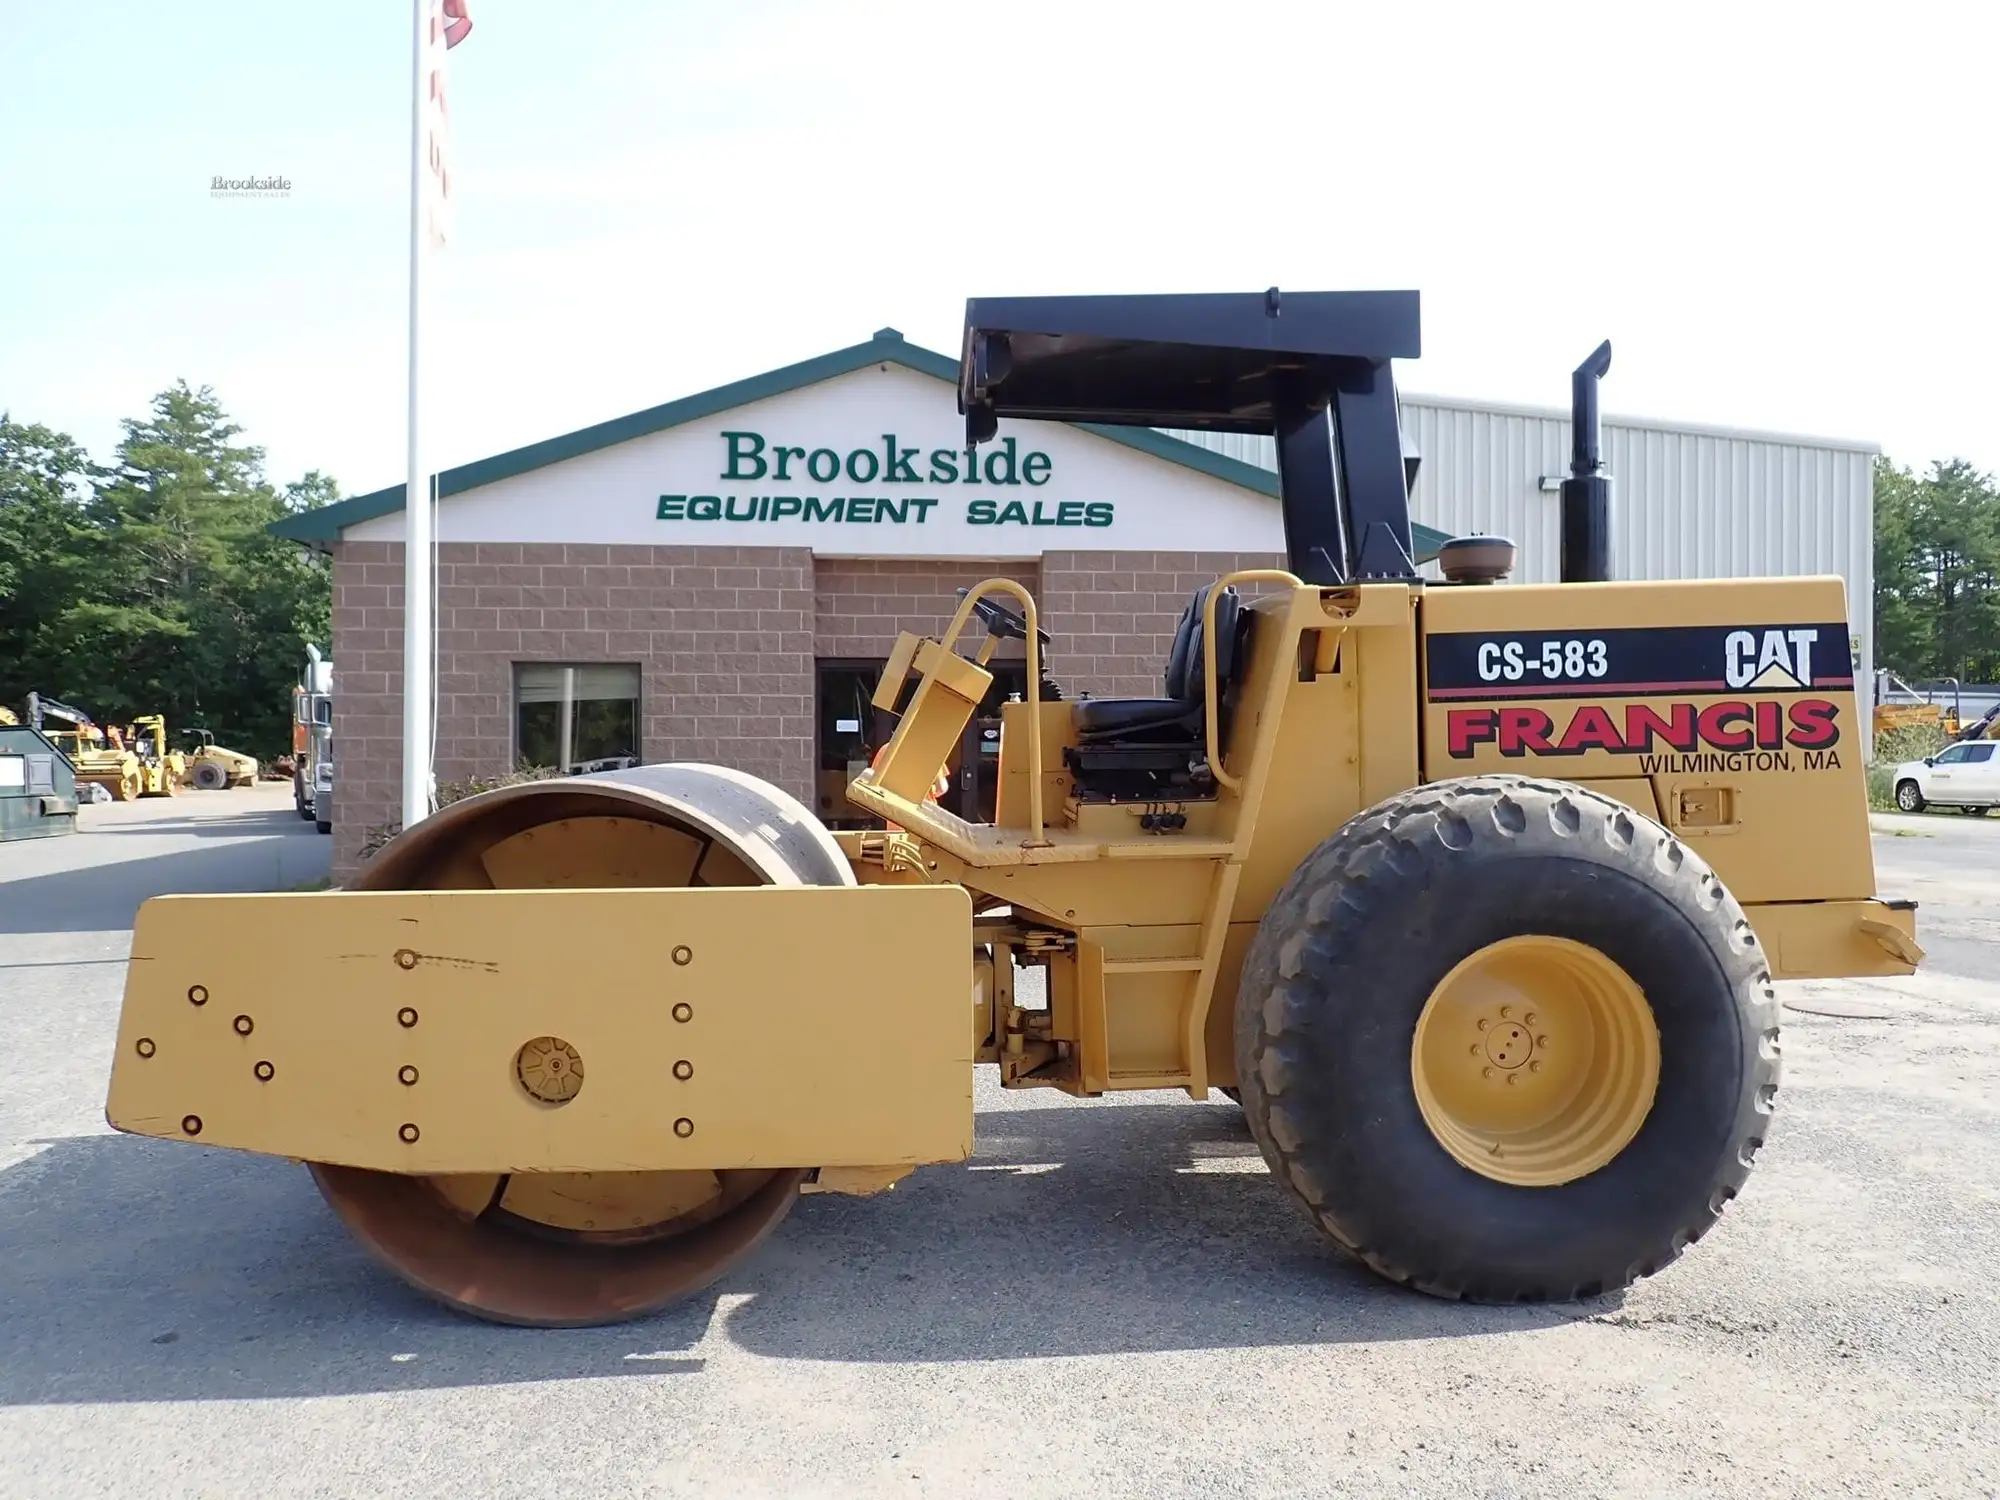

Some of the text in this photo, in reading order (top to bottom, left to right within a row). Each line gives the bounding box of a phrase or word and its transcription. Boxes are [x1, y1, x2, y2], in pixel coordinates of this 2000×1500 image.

[720, 431, 1052, 485] Brookside
[656, 494, 1115, 527] EQUIPMENT SALES
[1477, 629, 1818, 688] CS-583 CAT
[1447, 700, 1841, 759] FRANCIS
[1639, 751, 1841, 774] WILMINGTON, MA
